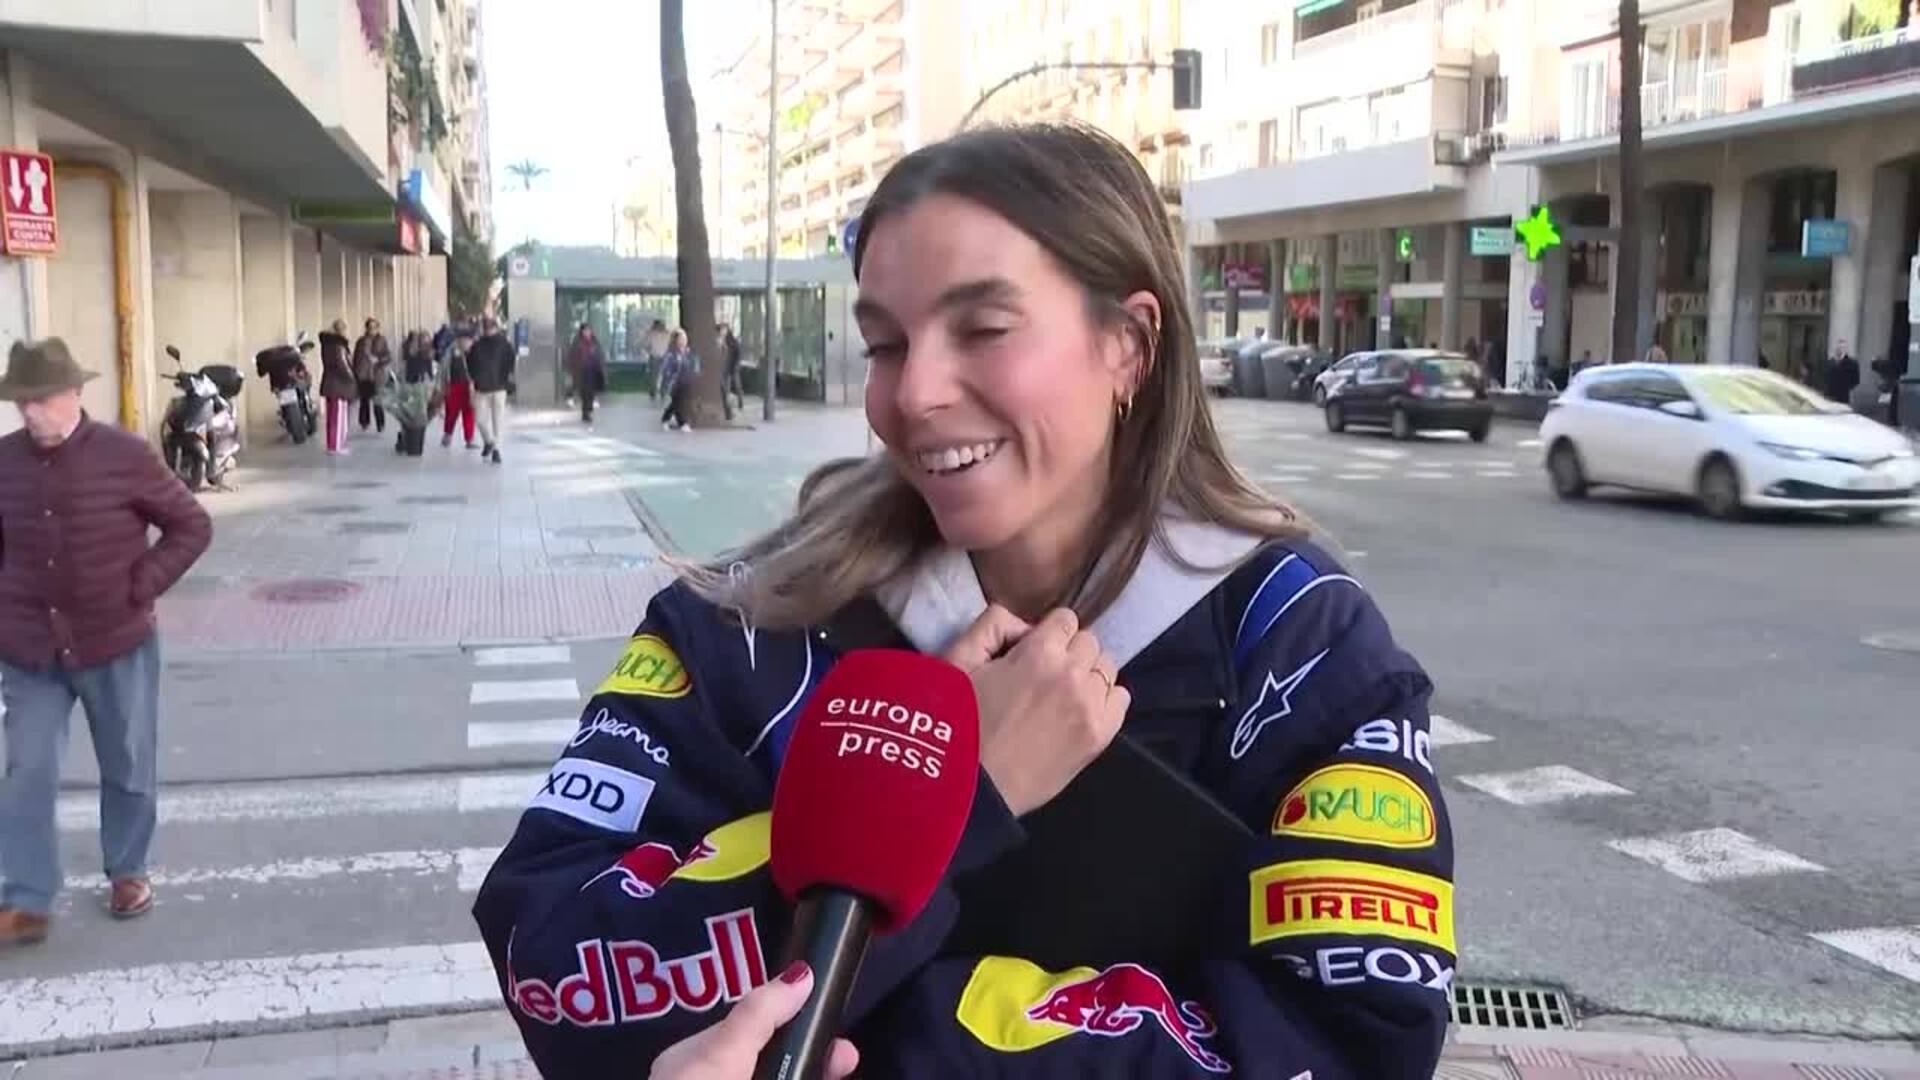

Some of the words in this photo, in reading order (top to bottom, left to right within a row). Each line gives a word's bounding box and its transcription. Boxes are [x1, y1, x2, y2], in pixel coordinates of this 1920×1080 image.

[612, 652, 684, 688] UCH
[827, 698, 953, 743] europa
[837, 731, 943, 779] press
[1308, 786, 1425, 837] RAUCH
[1265, 876, 1440, 935] PIRELLI
[606, 907, 768, 1022] Bull
